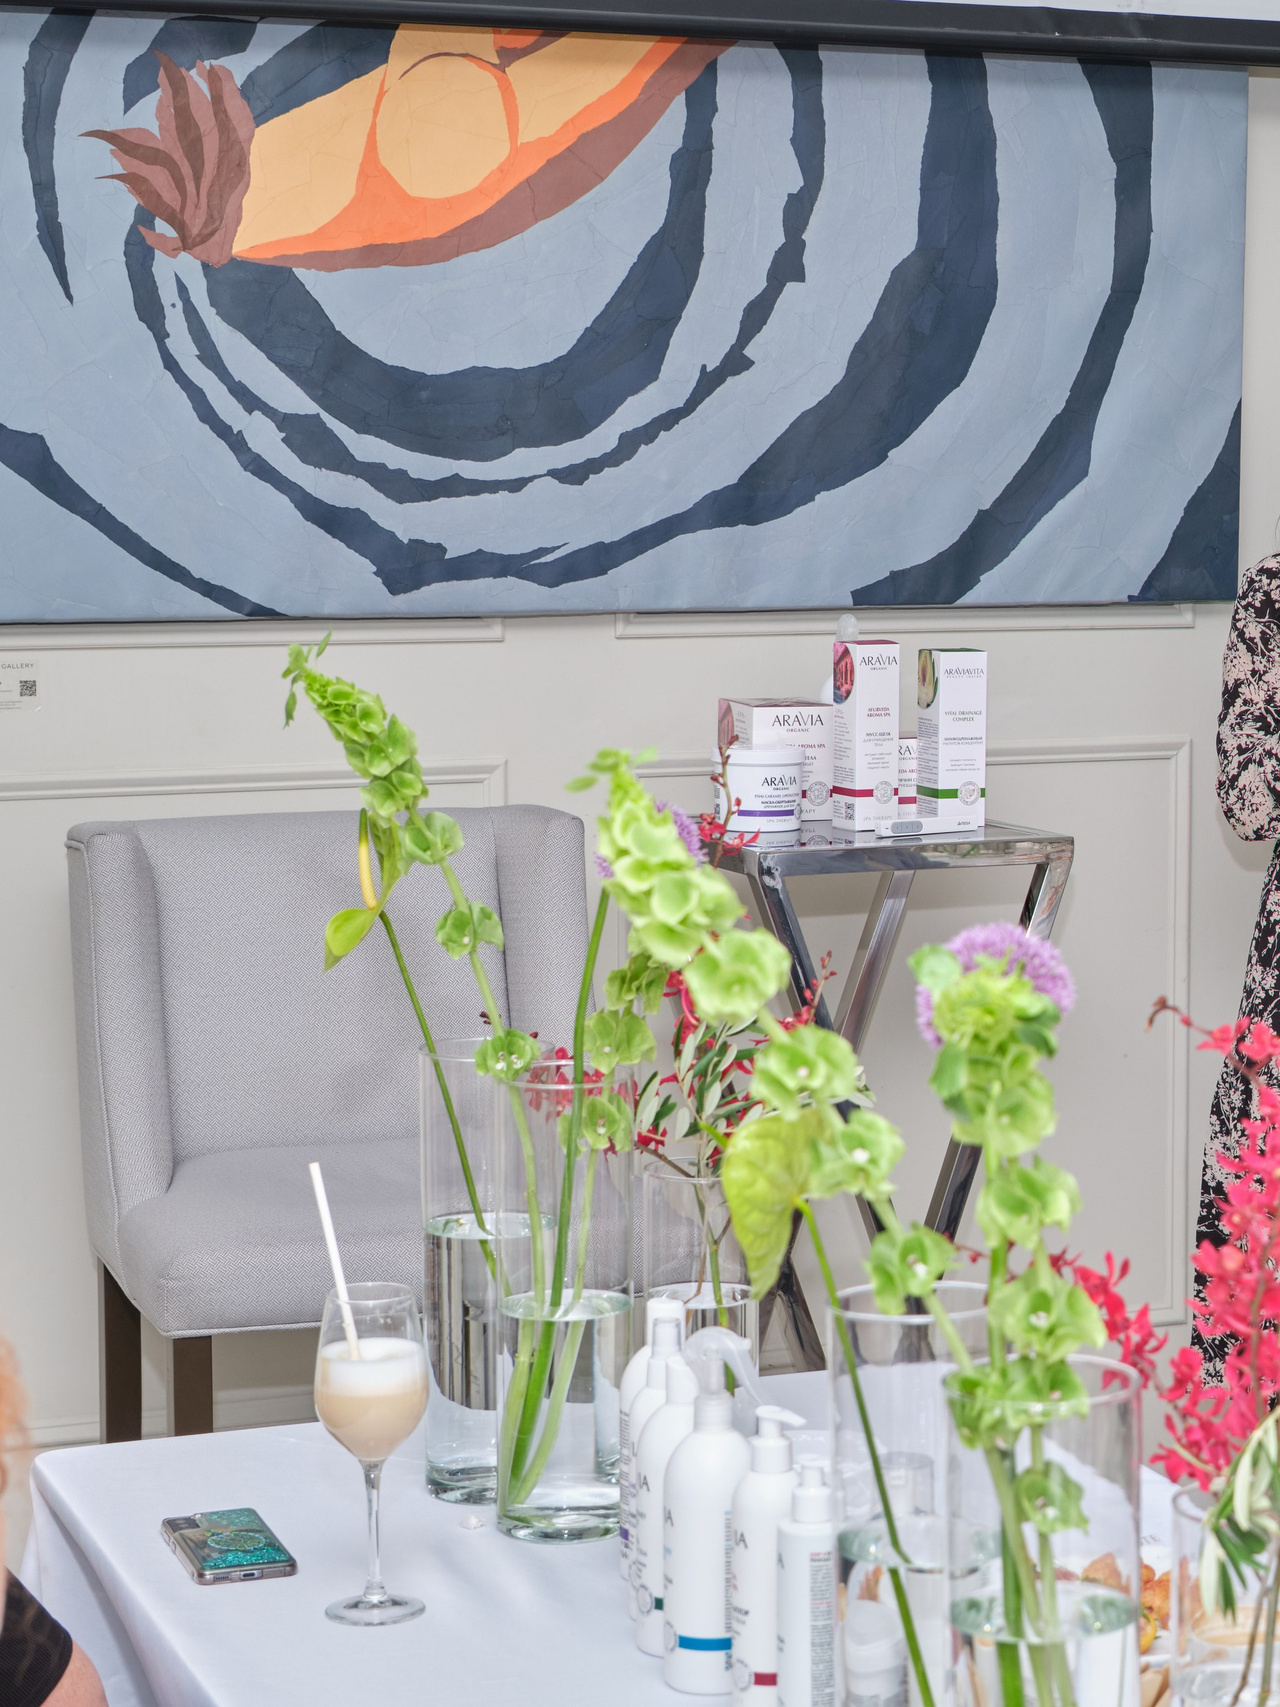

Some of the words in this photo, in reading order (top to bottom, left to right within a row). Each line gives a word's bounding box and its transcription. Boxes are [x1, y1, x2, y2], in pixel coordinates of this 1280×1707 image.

[860, 653, 898, 666] ARAVIA
[1, 662, 35, 670] GALLERY
[943, 667, 985, 676] ARAVIAVITA
[771, 711, 825, 727] ARAVIA
[761, 774, 797, 786] ARAVIA
